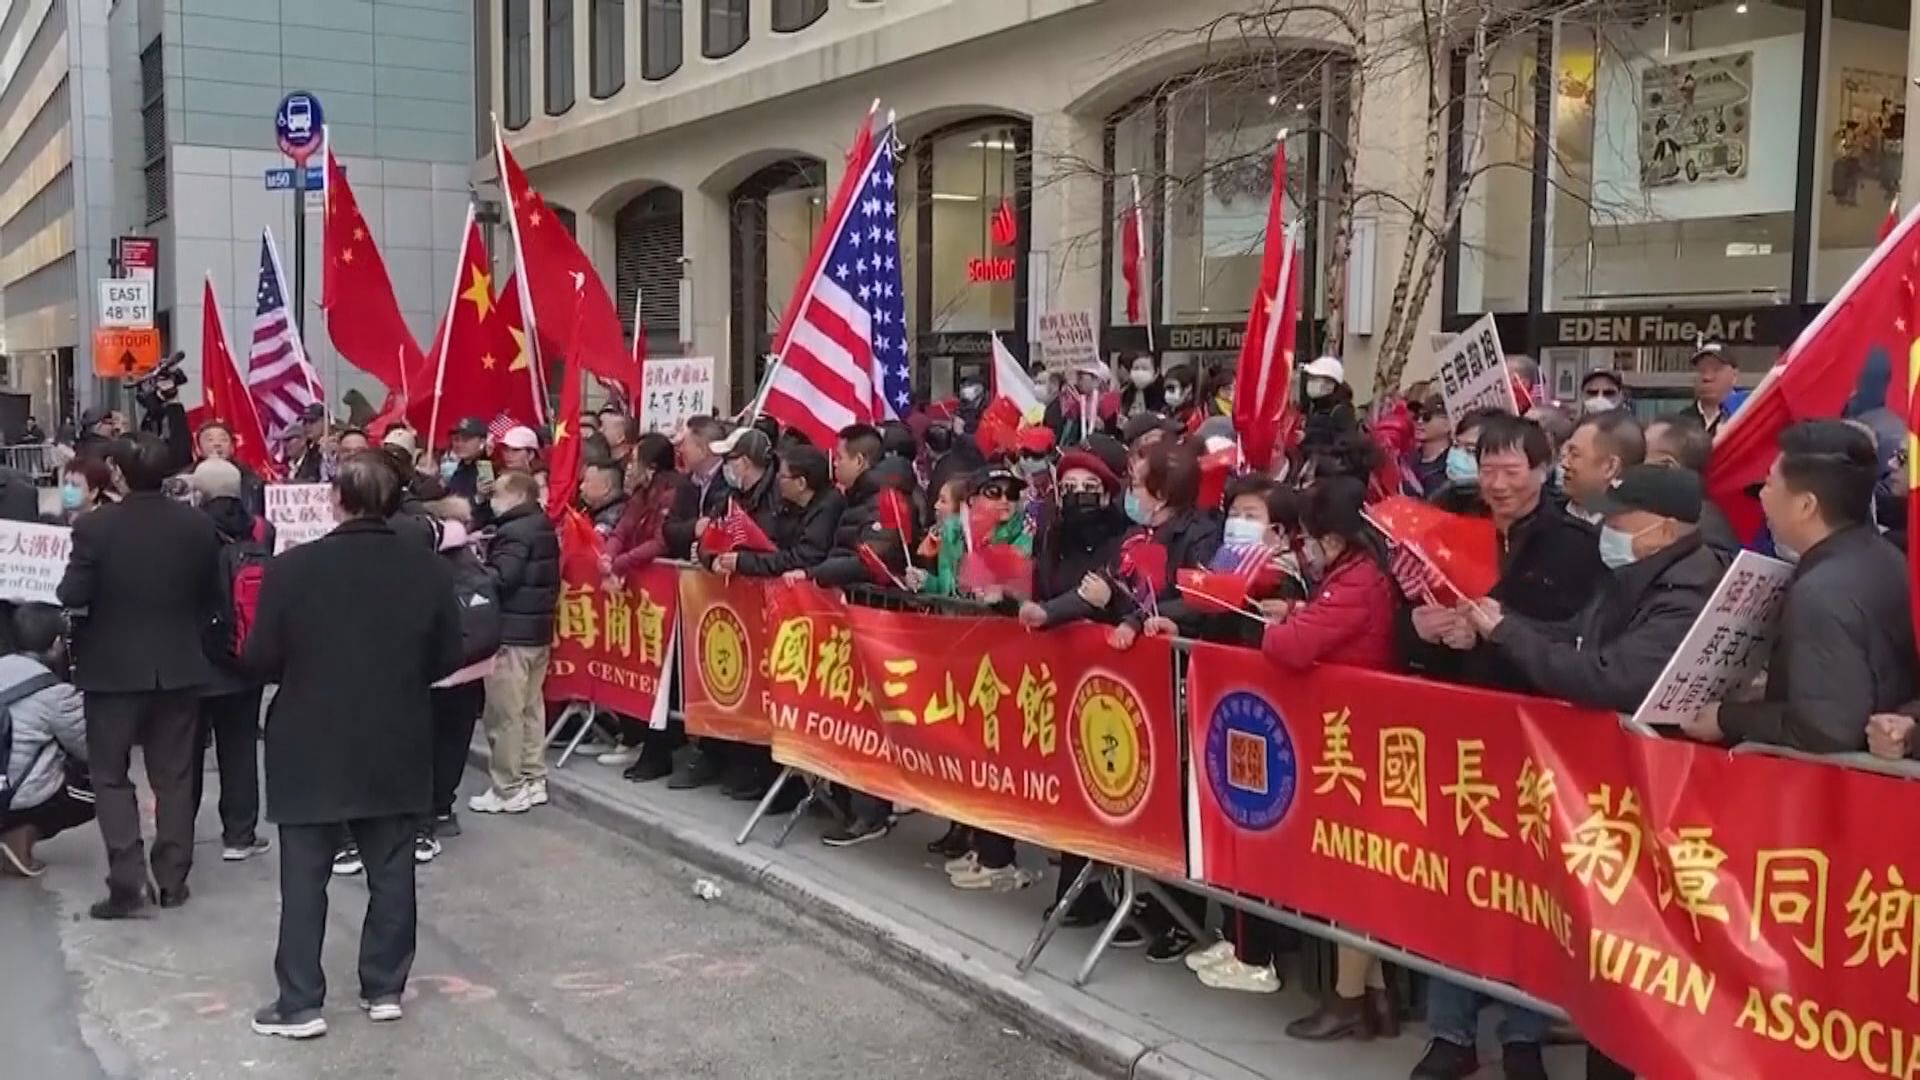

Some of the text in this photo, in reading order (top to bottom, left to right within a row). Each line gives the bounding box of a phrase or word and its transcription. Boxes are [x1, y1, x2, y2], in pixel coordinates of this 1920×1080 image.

[109, 287, 142, 300] EAST
[133, 305, 147, 319] ST
[1169, 328, 1213, 348] EDEN
[1559, 313, 1757, 342] EDEN Fine Art
[806, 710, 934, 775] FOUNDAION
[939, 753, 964, 783] IN
[970, 759, 1016, 794] USA
[1022, 769, 1060, 805] INC
[1311, 818, 1450, 897] AMERICAN
